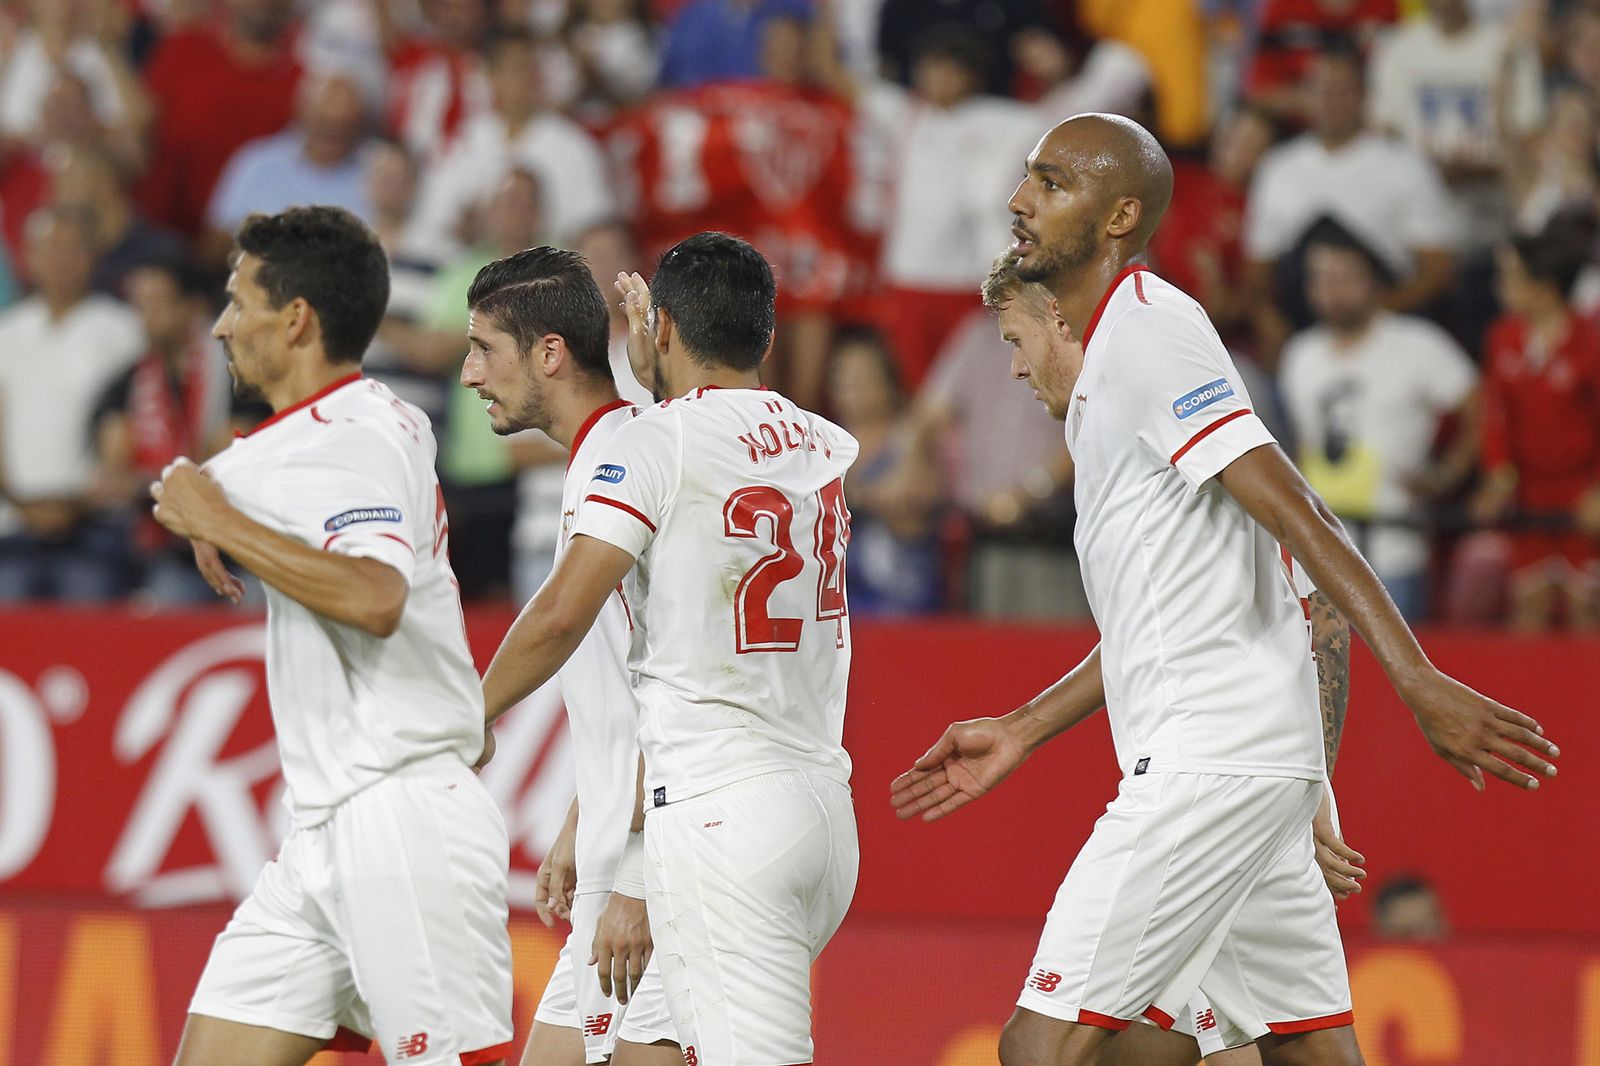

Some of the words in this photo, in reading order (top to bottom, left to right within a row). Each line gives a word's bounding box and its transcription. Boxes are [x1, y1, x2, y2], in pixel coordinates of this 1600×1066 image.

[1182, 382, 1231, 411] CORDIALIT
[335, 509, 401, 528] CORDIALITY
[723, 476, 852, 655] 24
